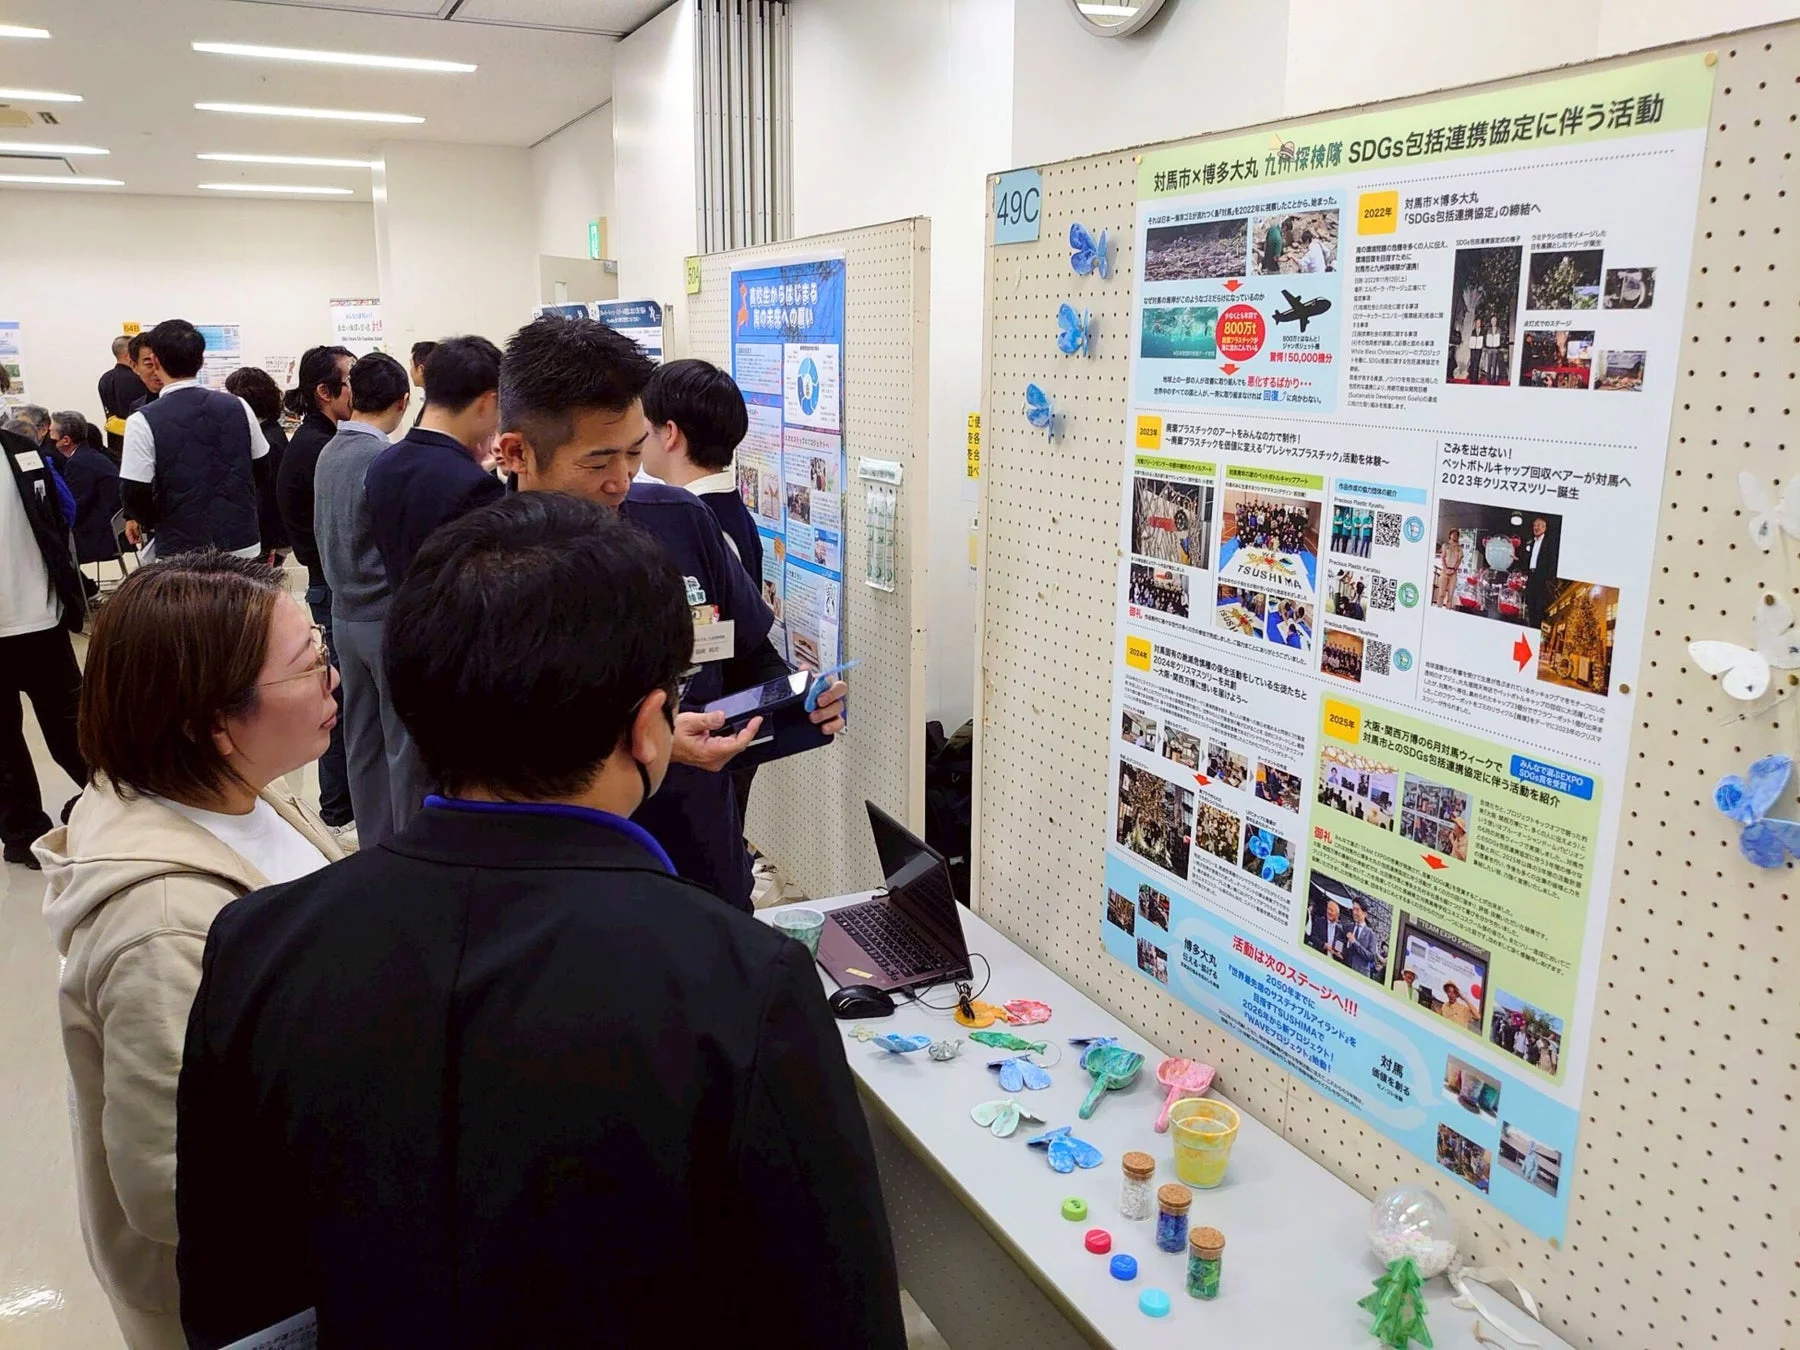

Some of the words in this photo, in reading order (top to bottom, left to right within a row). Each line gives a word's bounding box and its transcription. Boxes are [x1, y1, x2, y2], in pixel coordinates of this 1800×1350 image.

[1154, 157, 1259, 192] 対馬市×博多大丸
[1348, 92, 1665, 164] SDGs包括連携協定に伴う活動
[997, 187, 1039, 225] 49C
[1364, 207, 1392, 219] 2022年
[1404, 203, 1541, 225] 「SDGs包括連携協定」の締結へ
[750, 283, 818, 307] 高校生からはじまる
[1224, 322, 1257, 335] 800万t
[1139, 427, 1158, 437] 2023年
[1442, 473, 1580, 500] 2023年クリスマスツリー誕生
[1237, 565, 1302, 589] TSUSHIMA
[1130, 648, 1148, 659] 2024年
[1329, 714, 1355, 730] 2025年
[1314, 826, 1333, 844] 御礼
[1184, 938, 1218, 968] 博多大丸
[1265, 974, 1316, 1010] 2050年までに
[1253, 994, 1325, 1042] 目指すTSUSHIMAで
[1380, 1054, 1404, 1079] 対馬
[1371, 1067, 1411, 1097] 価値を創る
